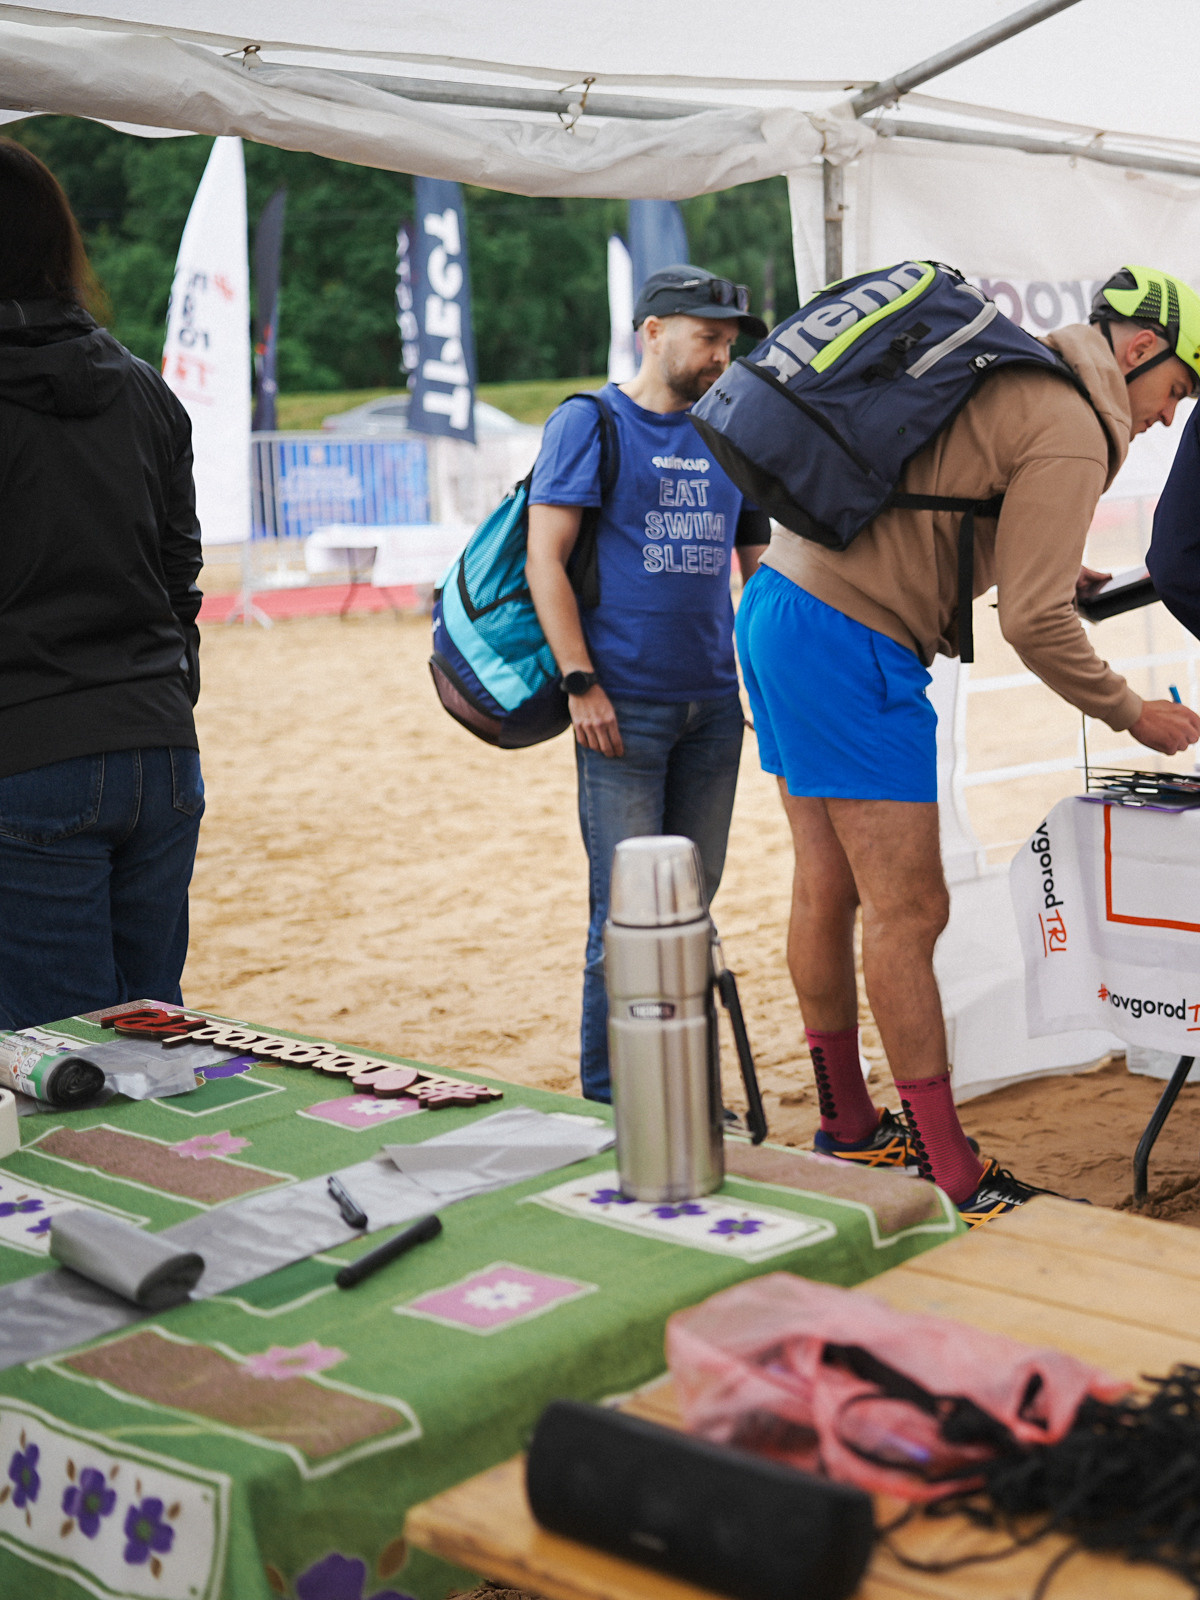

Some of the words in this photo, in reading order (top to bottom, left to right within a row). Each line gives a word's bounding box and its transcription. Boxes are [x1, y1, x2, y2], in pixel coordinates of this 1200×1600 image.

[658, 477, 711, 507] EAT
[644, 510, 725, 542] SWIM
[642, 543, 727, 576] SLEEP
